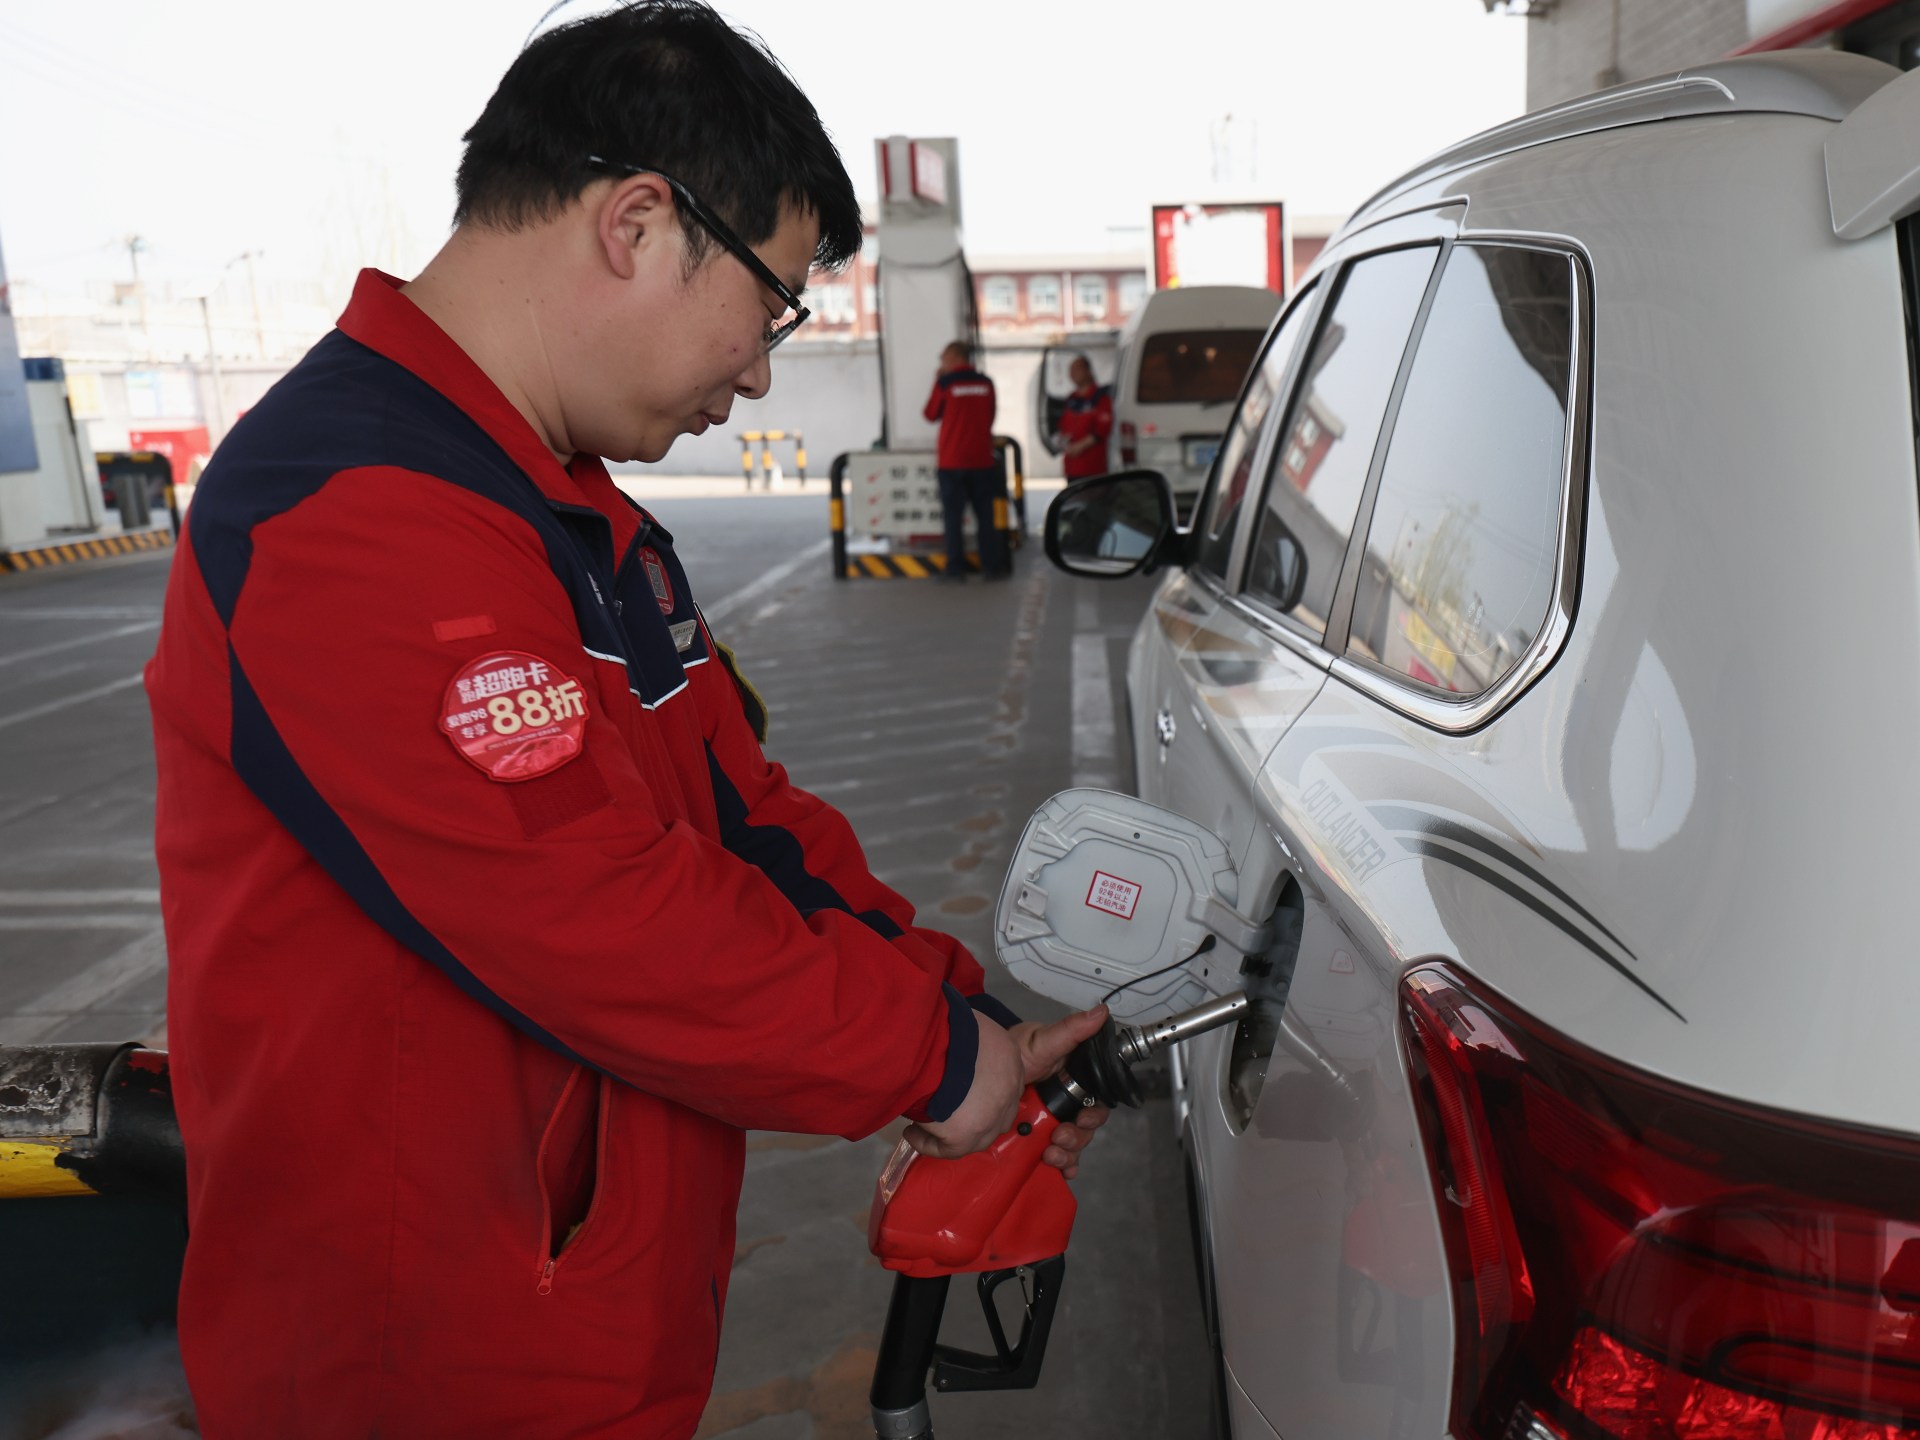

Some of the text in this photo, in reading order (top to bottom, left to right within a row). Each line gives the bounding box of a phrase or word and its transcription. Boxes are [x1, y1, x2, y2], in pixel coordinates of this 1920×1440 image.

[473, 662, 549, 698] 超跑卡
[487, 681, 585, 735] 88折
[1301, 779, 1386, 881] OUTLANDER
[1101, 880, 1132, 895] 必须使用
